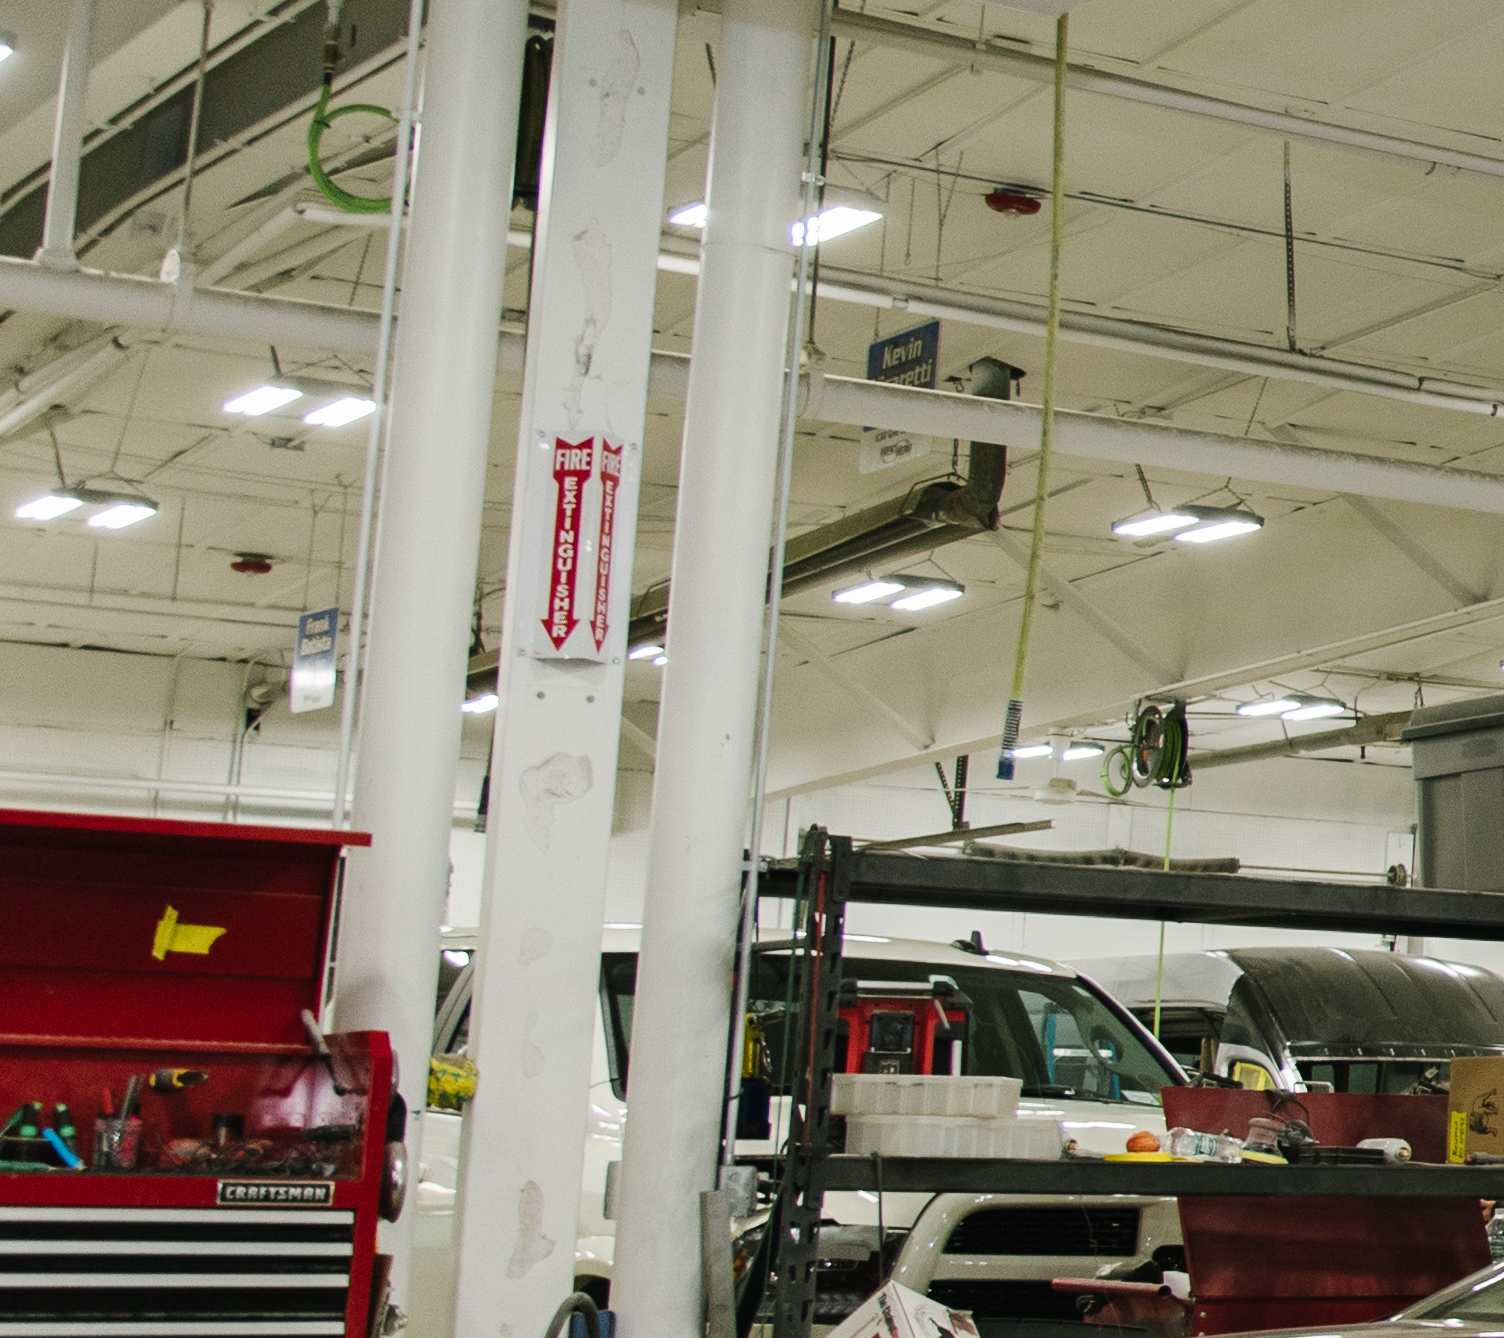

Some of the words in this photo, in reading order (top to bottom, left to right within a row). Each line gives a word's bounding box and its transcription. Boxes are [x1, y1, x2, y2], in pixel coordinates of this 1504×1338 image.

[883, 337, 923, 369] Kevin
[555, 449, 592, 471] FIRE
[552, 476, 578, 638] EXTINGUISHER
[595, 482, 615, 641] EXTINGUISHER
[225, 1186, 327, 1201] CRAFTSMAN
